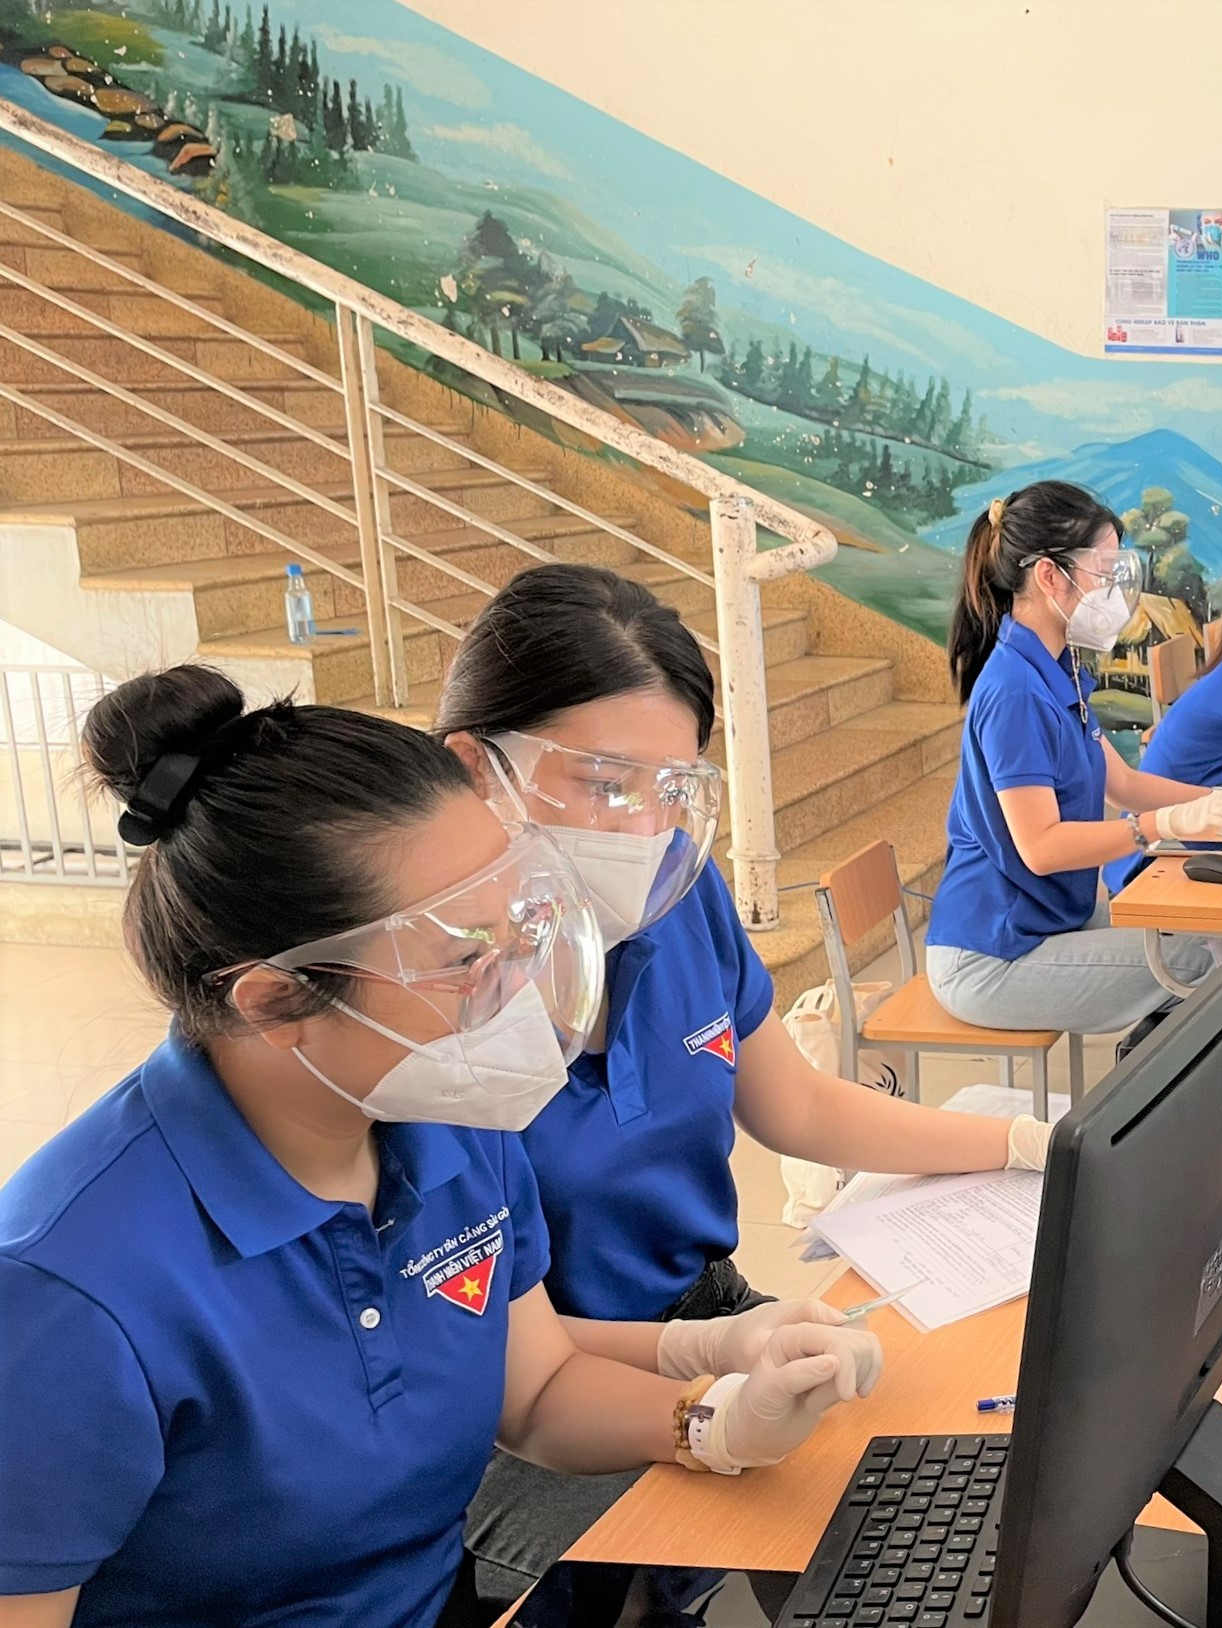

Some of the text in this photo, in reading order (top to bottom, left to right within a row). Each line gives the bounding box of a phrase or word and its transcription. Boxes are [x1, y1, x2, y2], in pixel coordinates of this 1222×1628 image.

[1197, 250, 1219, 260] WHO
[458, 1226, 487, 1244] CẢNG
[460, 1249, 483, 1268] VIỆT
